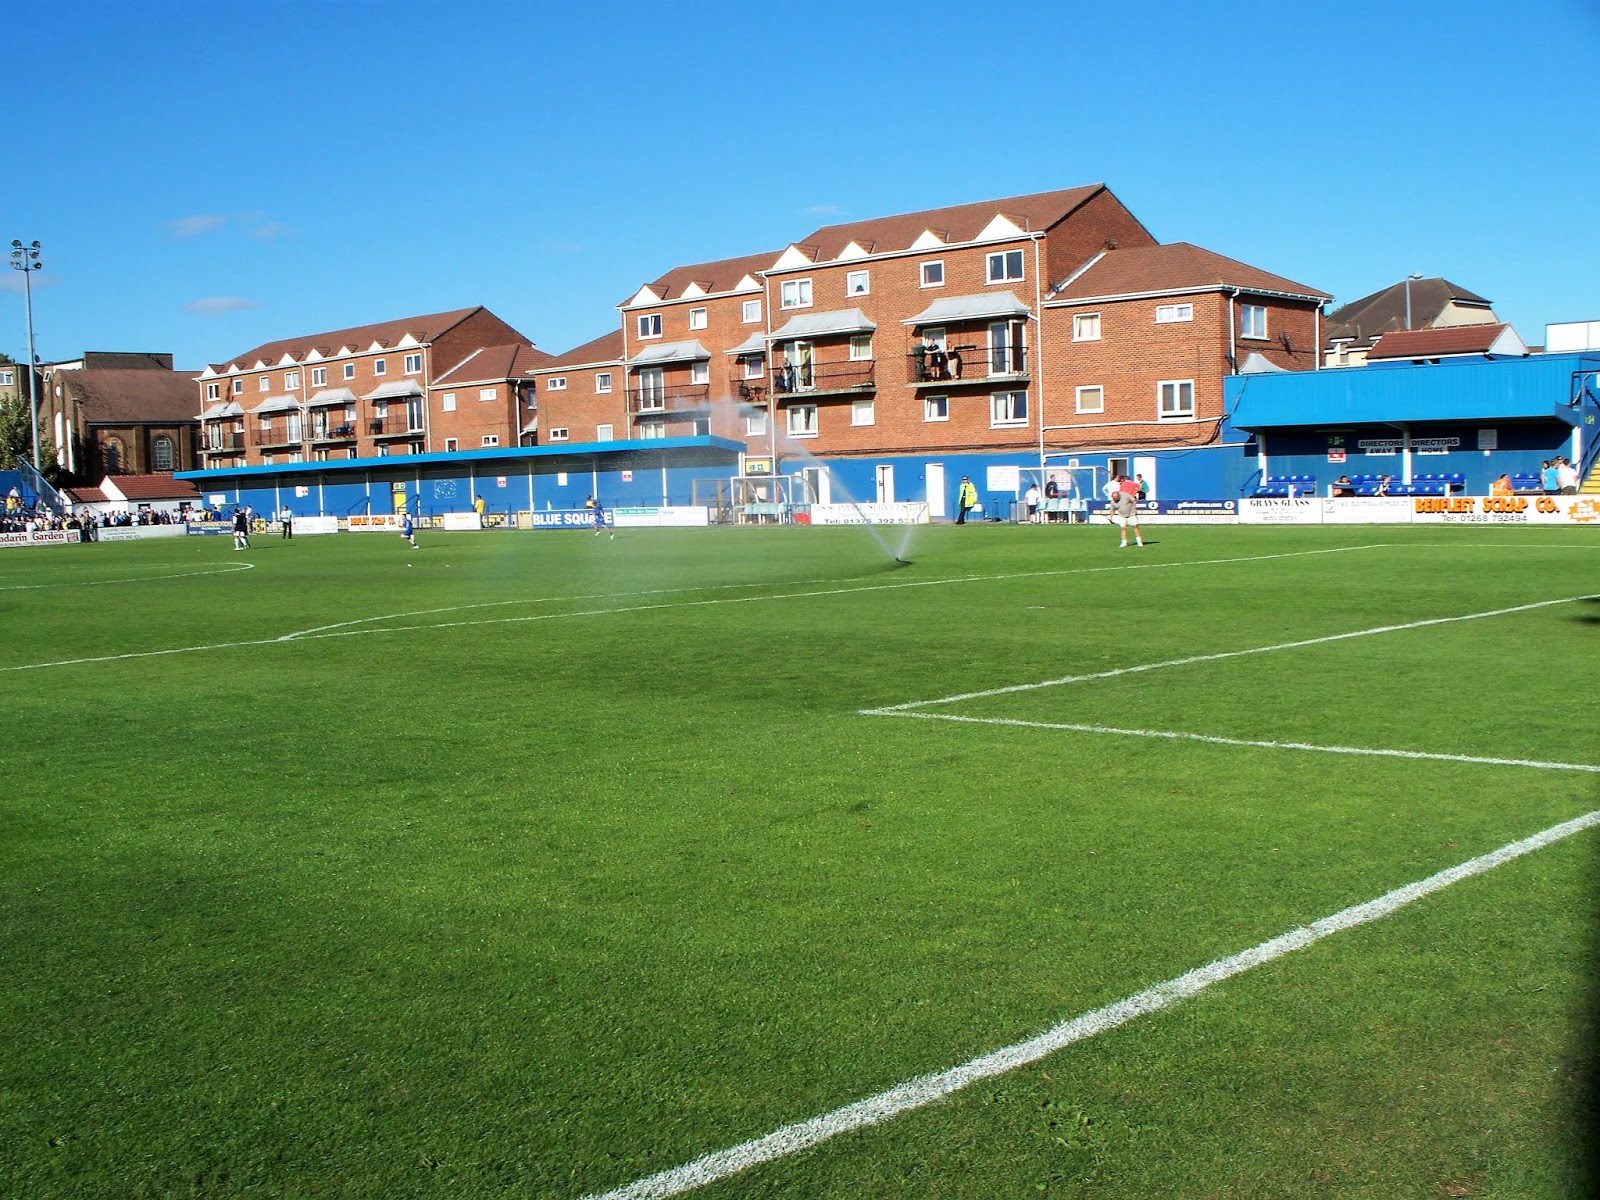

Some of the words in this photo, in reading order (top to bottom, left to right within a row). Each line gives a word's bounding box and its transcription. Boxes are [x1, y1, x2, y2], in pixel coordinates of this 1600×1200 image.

[1411, 438, 1458, 446] DIRECTORS
[1250, 499, 1279, 507] GRAYS
[1281, 499, 1310, 507] GLASS
[1415, 498, 1475, 513] BENFLEET
[1482, 497, 1528, 513] SCRAP
[1535, 497, 1560, 513] CO.
[533, 513, 562, 525] BLUE
[564, 512, 613, 525] SQUAE
[32, 532, 64, 541] Garden
